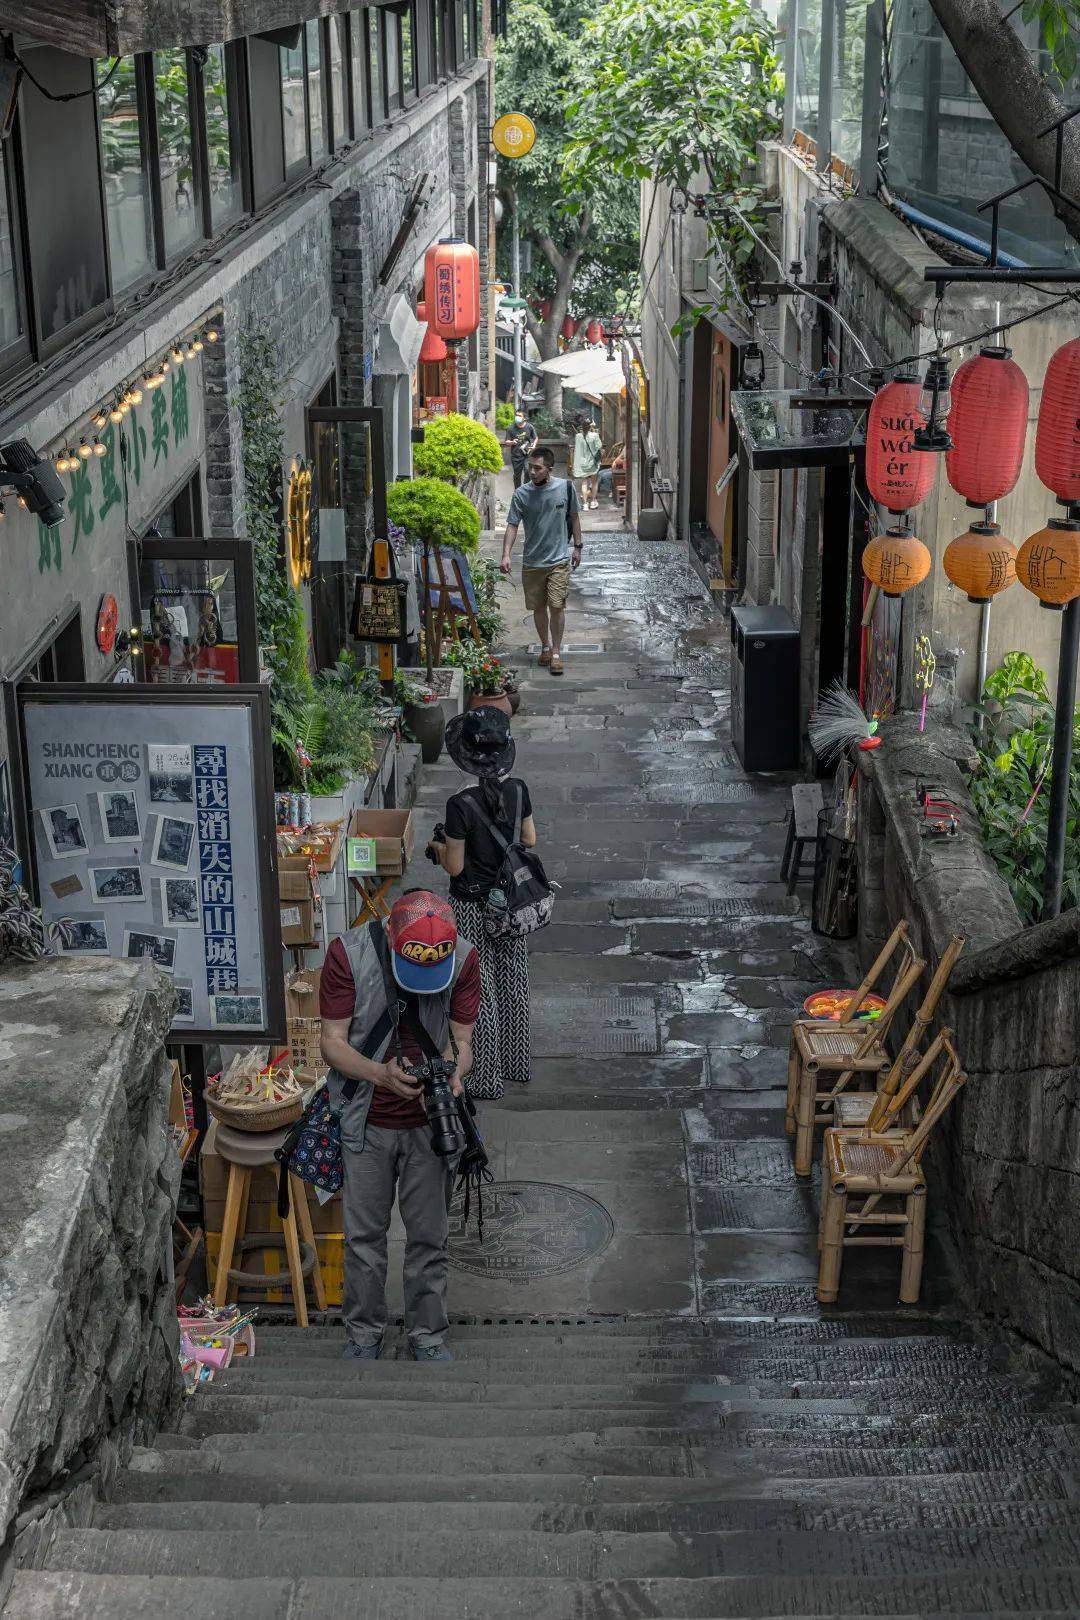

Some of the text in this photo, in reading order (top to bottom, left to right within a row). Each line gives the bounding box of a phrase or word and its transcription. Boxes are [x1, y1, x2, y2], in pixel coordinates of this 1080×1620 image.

[439, 268, 452, 320] 蜀绣传习
[880, 435, 912, 453] wá
[886, 457, 908, 475] ér
[42, 742, 140, 759] SHANCHENG
[44, 763, 93, 778] XIANG
[195, 747, 238, 996] 尋找消失的山城巷
